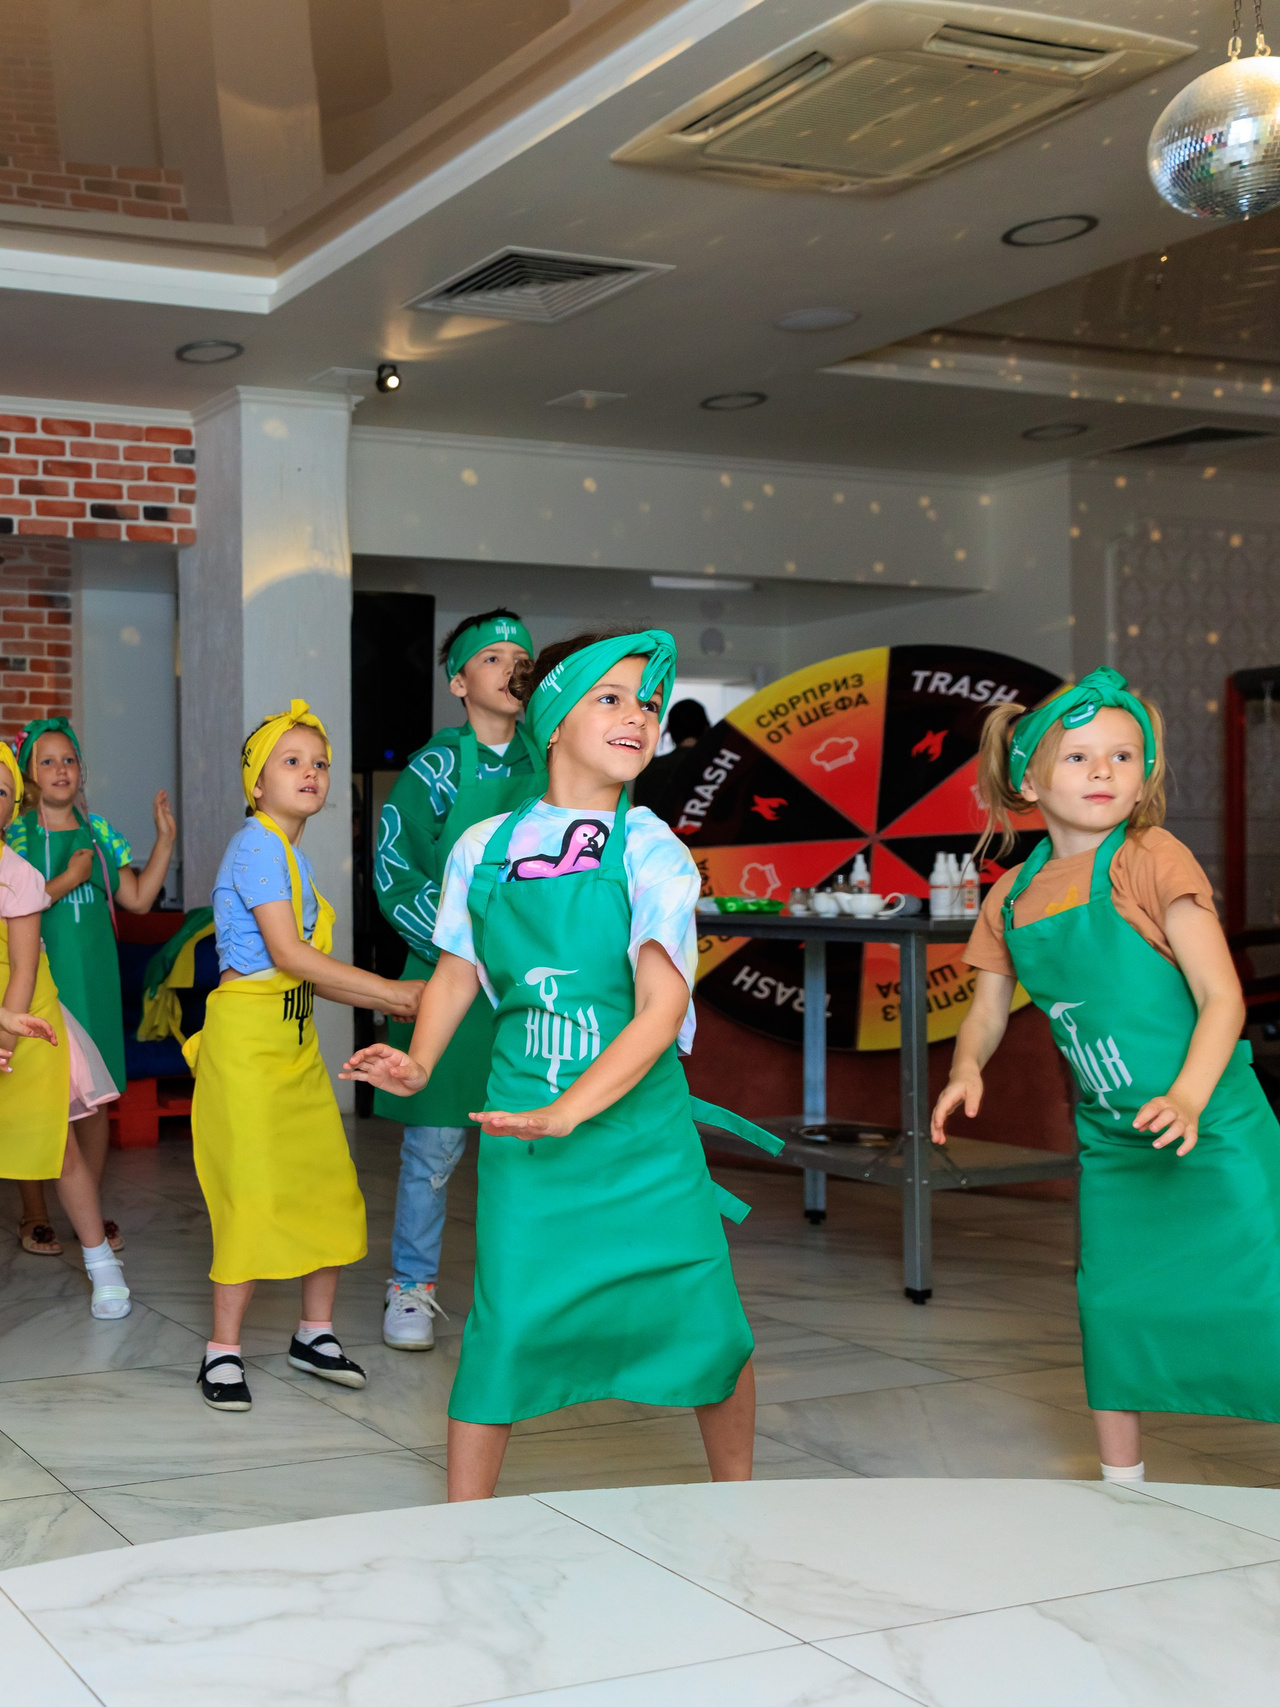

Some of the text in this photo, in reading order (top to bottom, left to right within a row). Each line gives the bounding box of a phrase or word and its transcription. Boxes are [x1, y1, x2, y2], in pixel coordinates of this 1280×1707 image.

[756, 673, 865, 729] СЮРПРИЗ
[911, 670, 1020, 705] TRASH
[766, 692, 870, 744] ОТ ШЕФА
[696, 858, 714, 897] ЕФА
